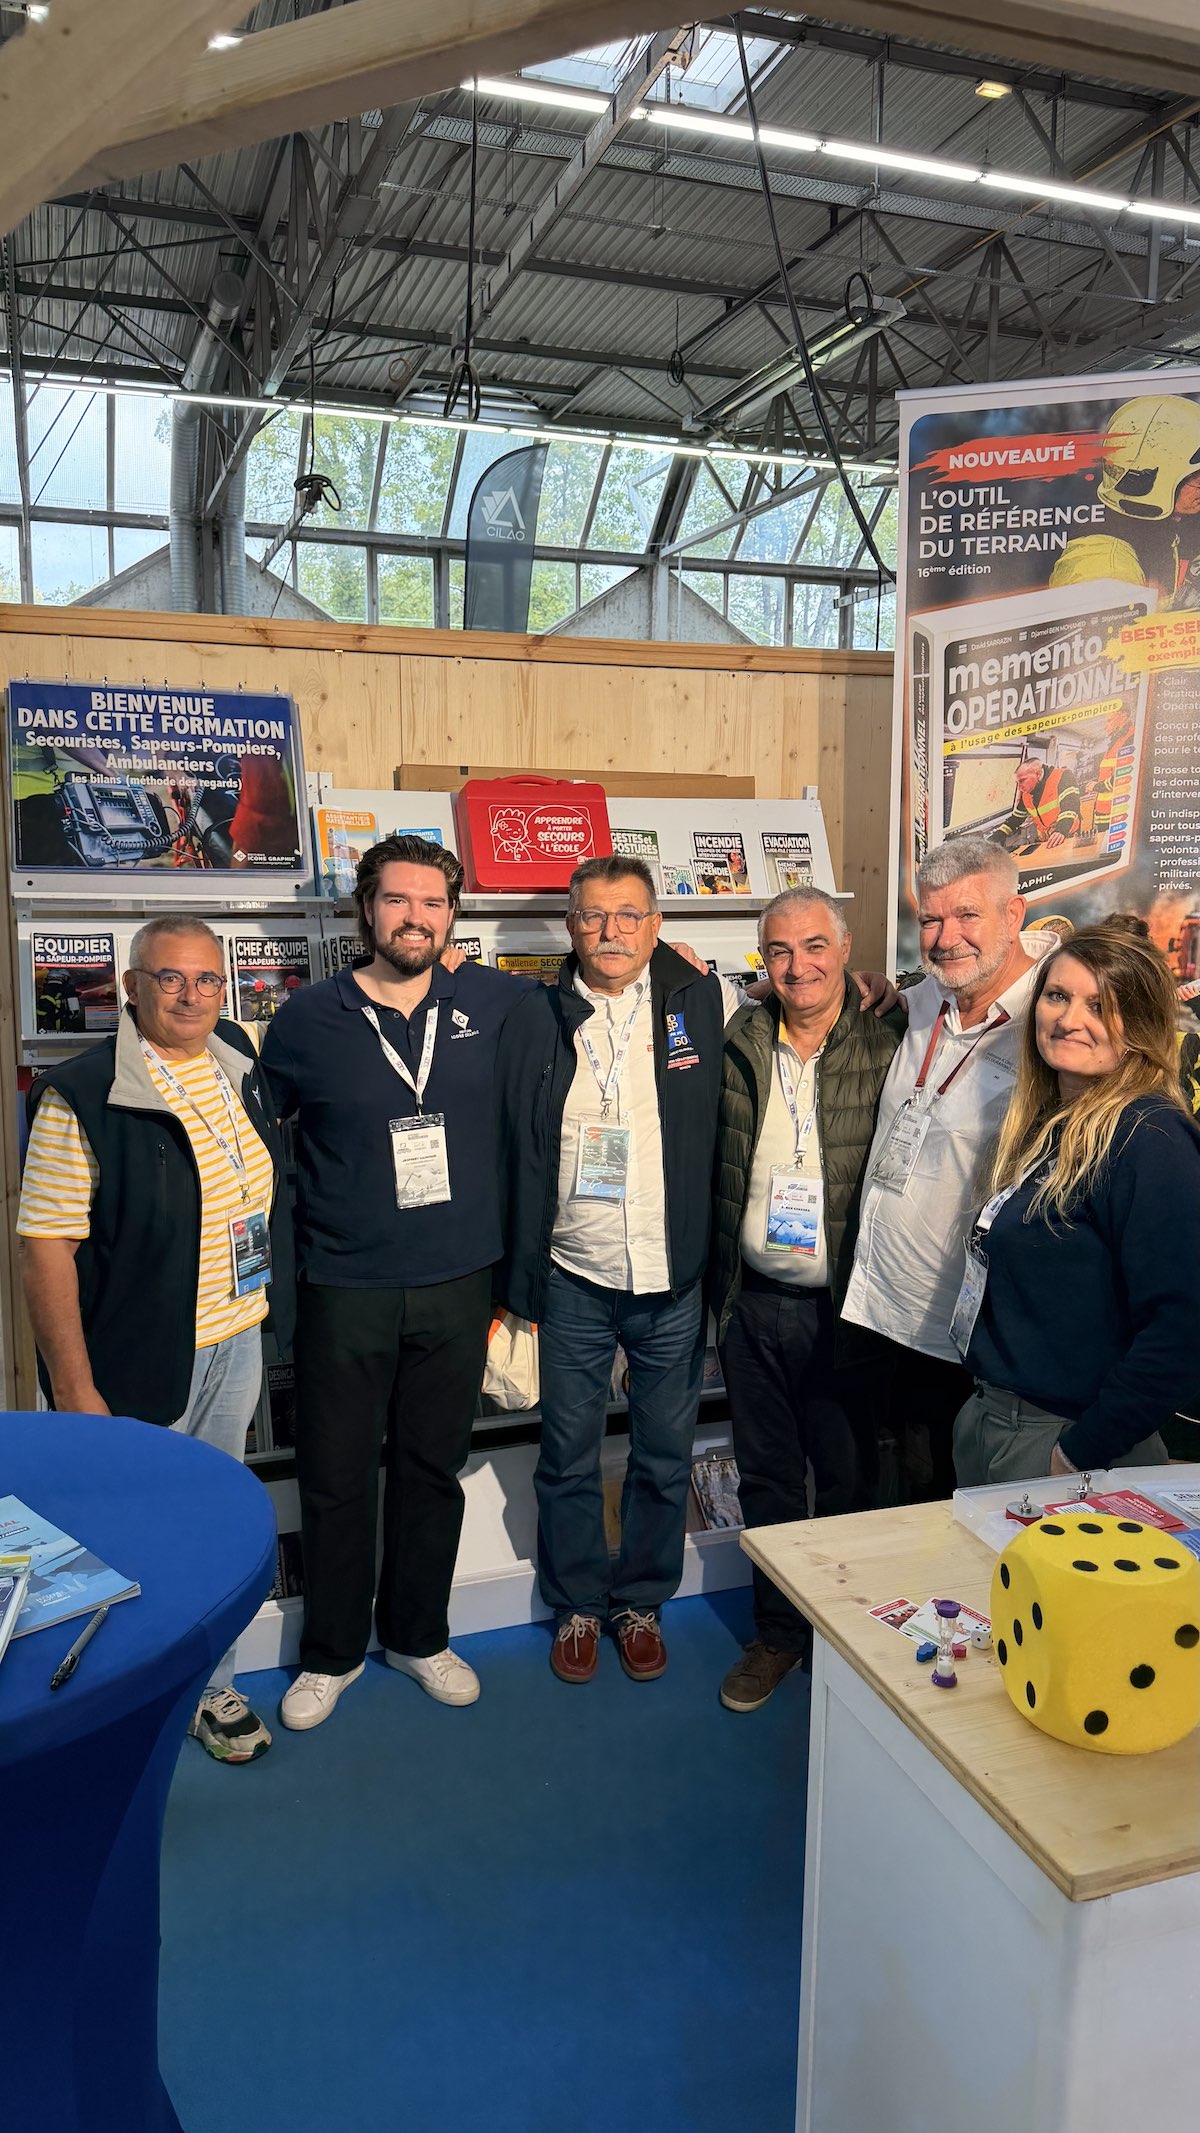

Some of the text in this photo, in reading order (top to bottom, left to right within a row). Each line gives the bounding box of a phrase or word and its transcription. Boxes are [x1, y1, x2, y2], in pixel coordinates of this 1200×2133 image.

[949, 443, 1075, 470] NOUVEAUTÉ
[919, 504, 1106, 535] DE RÉFÉRENCE
[919, 531, 1067, 559] DU TERRAIN
[917, 564, 991, 578] 16ème édition
[1160, 639, 1176, 649] de
[949, 633, 1103, 695] memento
[1164, 676, 1187, 686] Clair
[91, 691, 215, 716] BIENVENUE
[18, 708, 285, 739] DANS CETTE FORMATION
[950, 702, 1118, 752] à l'usage des sapeurs-pompiers
[1155, 722, 1200, 732] Conçu p
[1155, 734, 1174, 742] des
[25, 730, 281, 760] Secouristes, Sapeurs-Pompiers,
[1154, 747, 1179, 756] pour
[1182, 745, 1190, 754] le
[106, 753, 215, 772] Ambulanciers
[1153, 766, 1188, 775] Brosse
[72, 773, 242, 791] les bilans (méthode des regards)
[1153, 778, 1167, 787] les
[1151, 810, 1166, 818] Un
[534, 816, 583, 825] APPRENDRE
[1150, 823, 1175, 832] pour
[537, 831, 585, 842] SECOURS
[611, 832, 653, 845] GESTES et
[695, 835, 742, 848] INCENDIE
[764, 836, 809, 848] EVACUATION
[546, 841, 580, 853] L'ÉCOLE
[612, 842, 659, 855] POSTURES
[696, 867, 729, 876] INCENDIE
[1159, 880, 1192, 891] privés.
[34, 937, 110, 955] ÉQUIPIER
[237, 940, 308, 957] CHEF d'ÉQUIPE
[47, 955, 112, 963] SAPEUR-POMPIER
[248, 958, 308, 966] SAPEUR-POMPIER
[500, 958, 566, 968] Challenge SECO
[674, 1035, 688, 1046] 50
